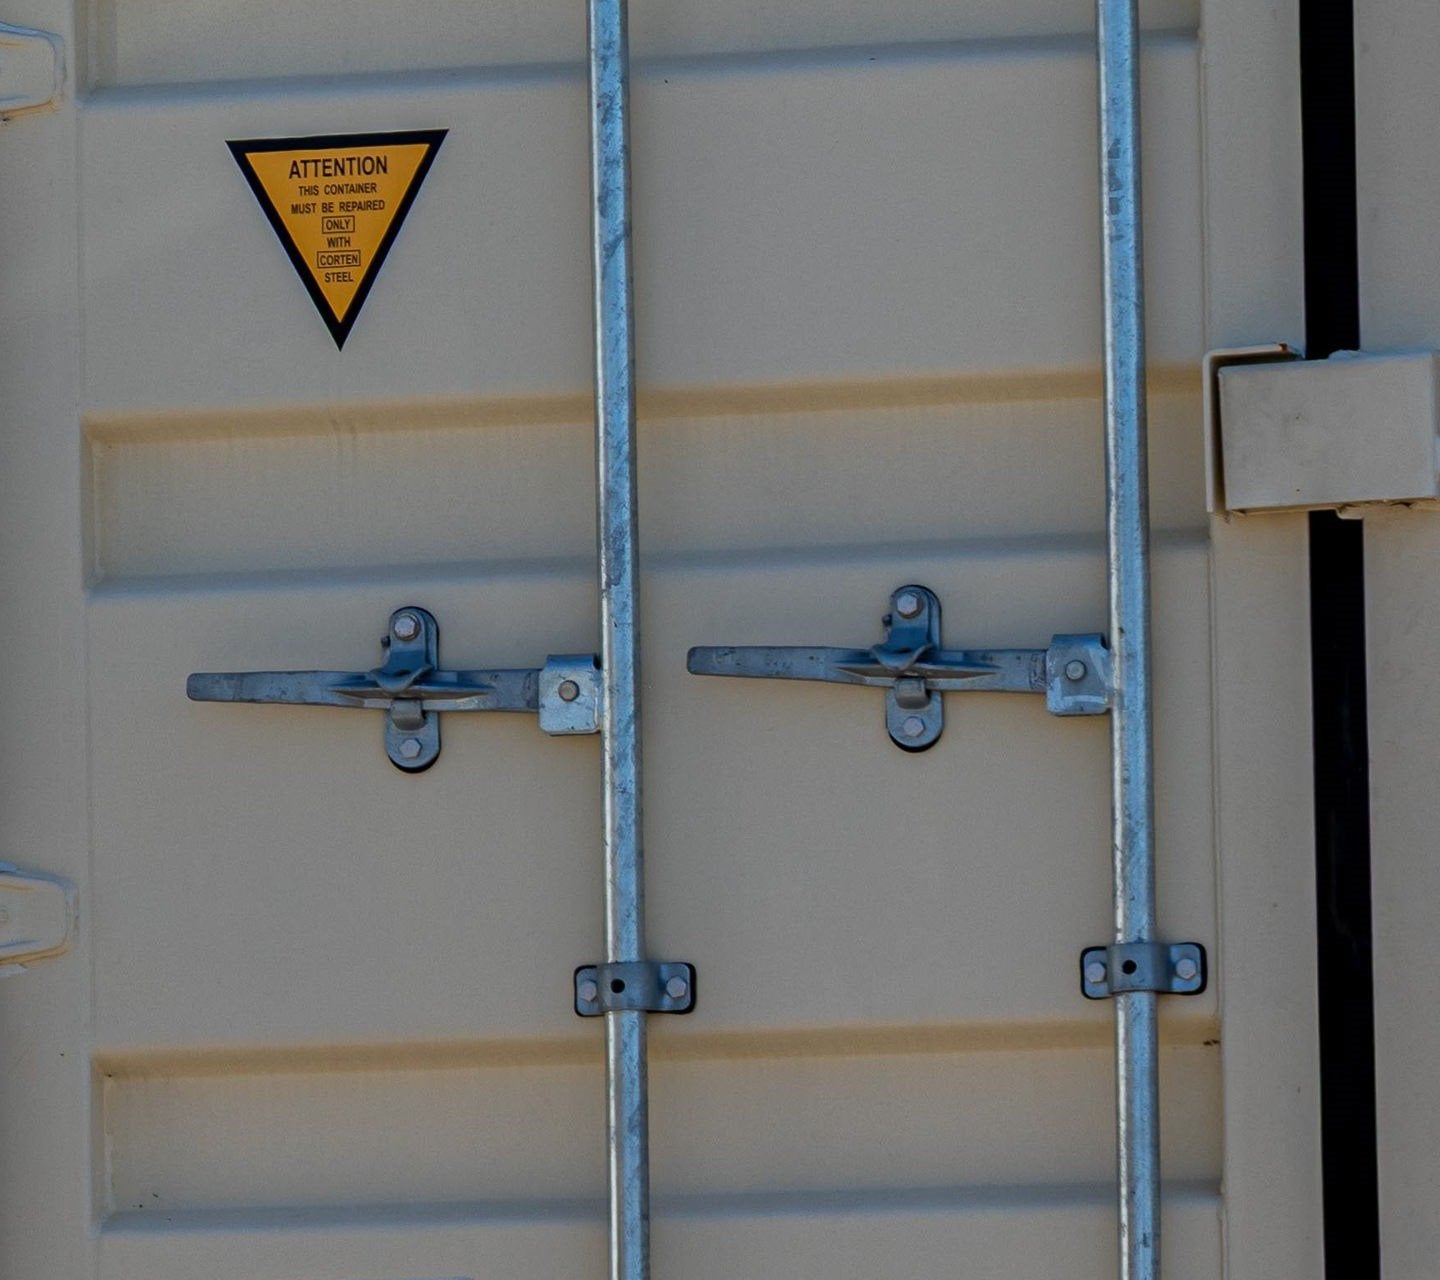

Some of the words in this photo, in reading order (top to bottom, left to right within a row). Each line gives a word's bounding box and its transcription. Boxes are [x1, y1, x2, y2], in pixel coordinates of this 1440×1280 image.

[288, 155, 388, 179] ATTENTION
[298, 185, 319, 197] THIS
[323, 182, 377, 195] CONTAINER
[291, 202, 316, 214] MUST
[321, 201, 334, 213] BE
[339, 199, 385, 212] REPAIRED
[326, 218, 351, 231] ONLY
[326, 236, 351, 248] WITH
[319, 253, 358, 266] CORTEN
[324, 271, 353, 284] STEEL
